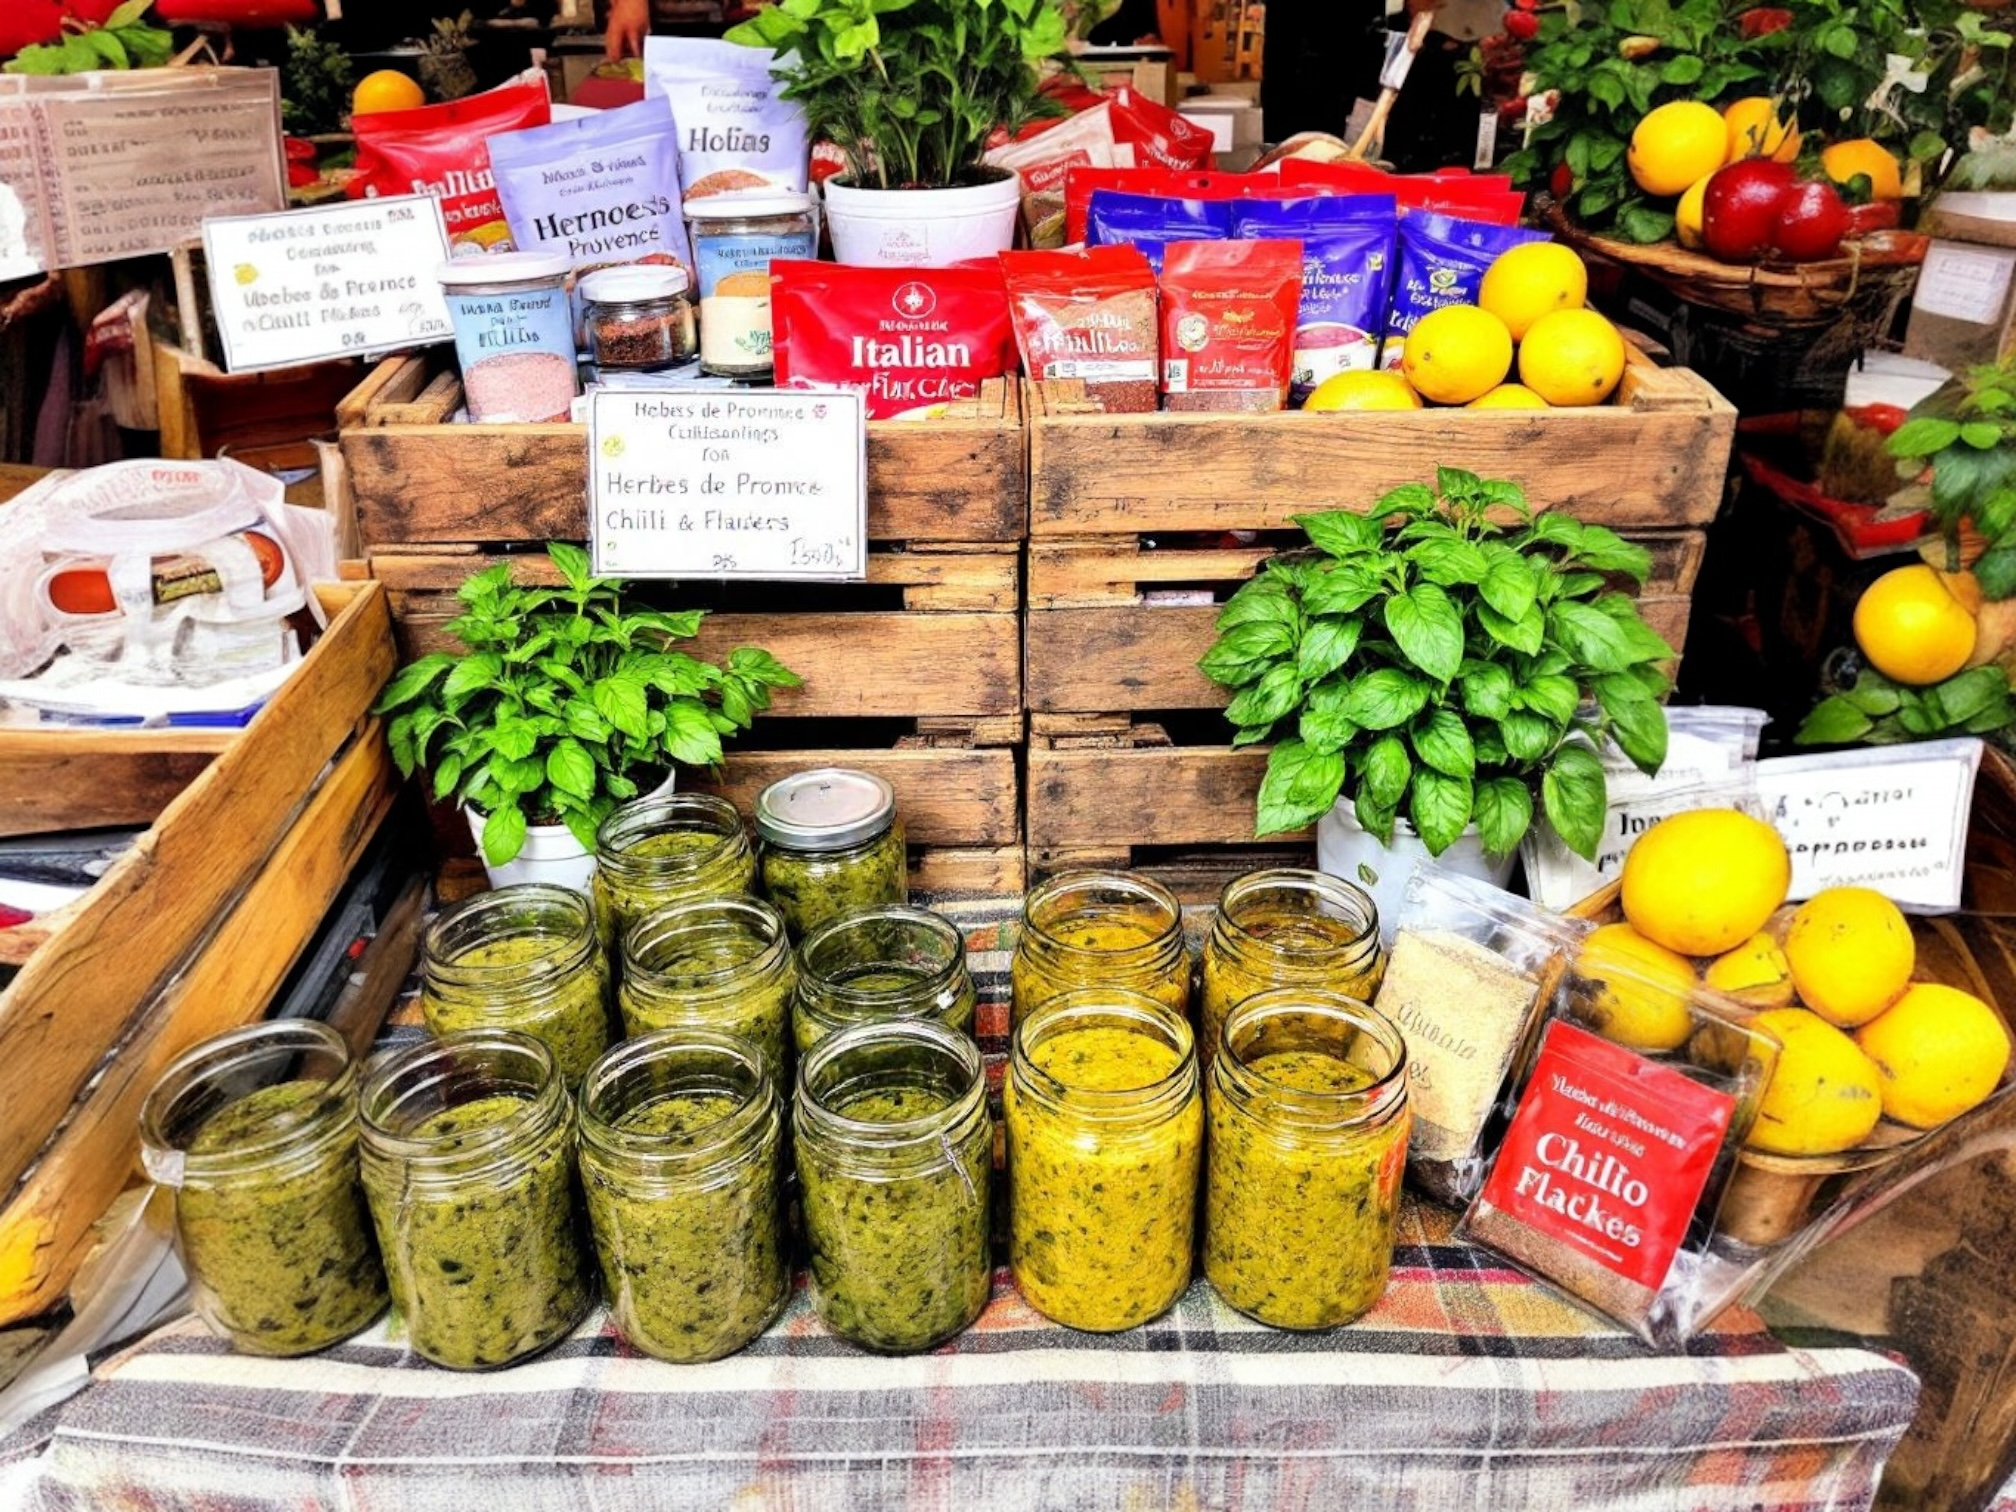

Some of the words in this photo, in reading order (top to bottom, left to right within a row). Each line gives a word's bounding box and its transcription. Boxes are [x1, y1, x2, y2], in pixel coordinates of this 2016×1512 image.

[852, 335, 971, 367] Italian
[702, 402, 720, 418] de
[700, 472, 725, 494] de
